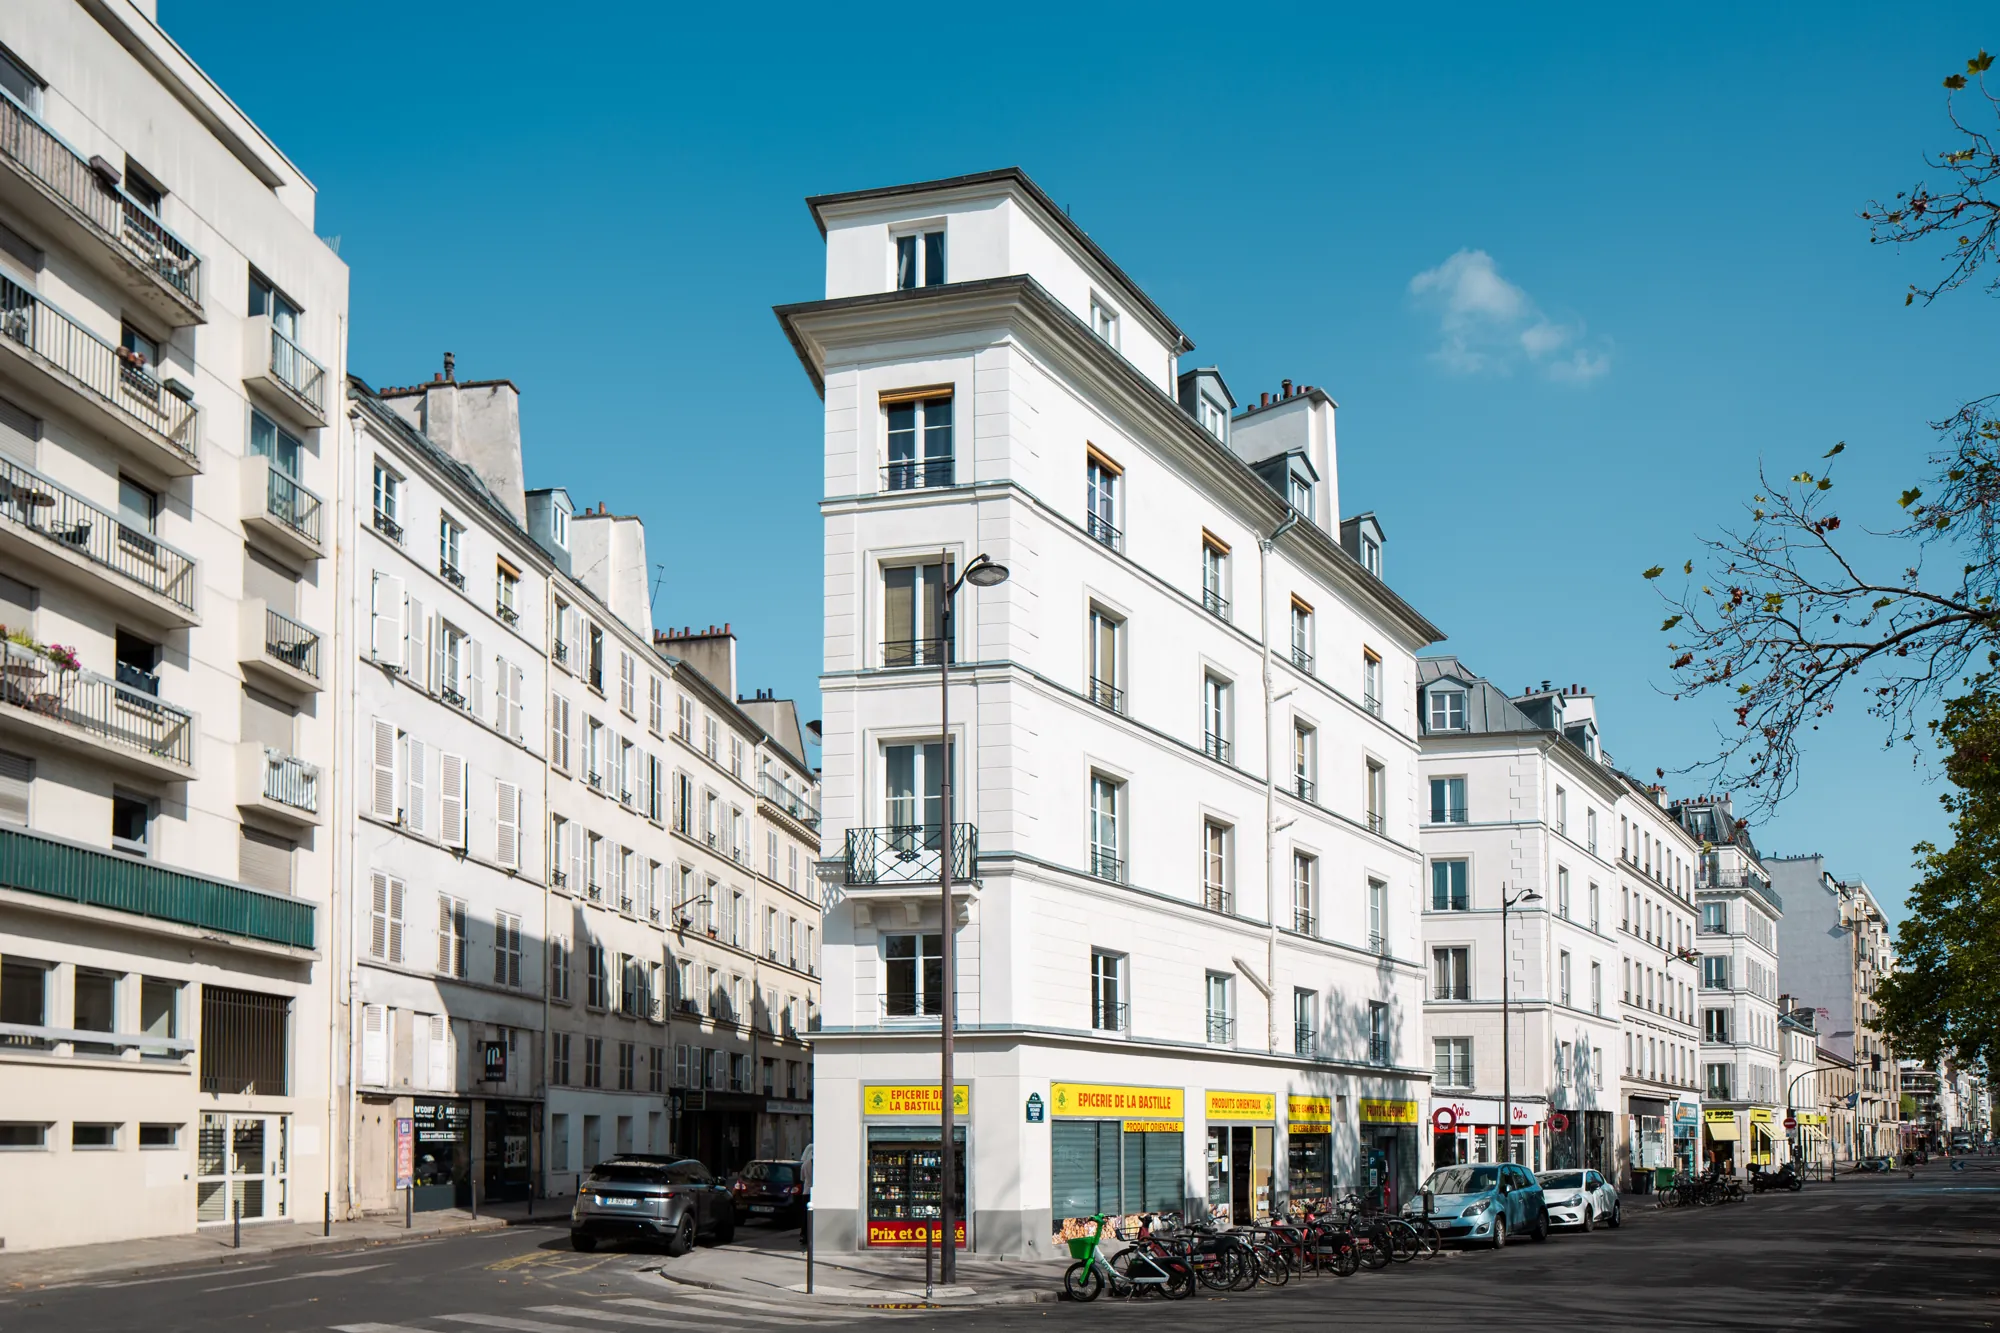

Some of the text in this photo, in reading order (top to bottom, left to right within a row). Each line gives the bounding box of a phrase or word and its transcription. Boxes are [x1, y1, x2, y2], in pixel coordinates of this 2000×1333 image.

[891, 1090, 930, 1099] EPICERIE
[1078, 1093, 1112, 1107] EPICERIE
[1115, 1094, 1124, 1108] DE
[1127, 1095, 1136, 1108] LA
[1139, 1096, 1171, 1109] BASTILLE
[1212, 1098, 1261, 1109] PRODUITS ORIENTAUX
[889, 1102, 901, 1111] LA
[1289, 1104, 1301, 1113] TOUTE
[1366, 1105, 1382, 1116] FRUITS
[1127, 1123, 1178, 1132] PRODUIT ORIENTALE
[1370, 1157, 1375, 1165] P
[870, 1228, 896, 1239] Prix
[899, 1228, 912, 1239] et
